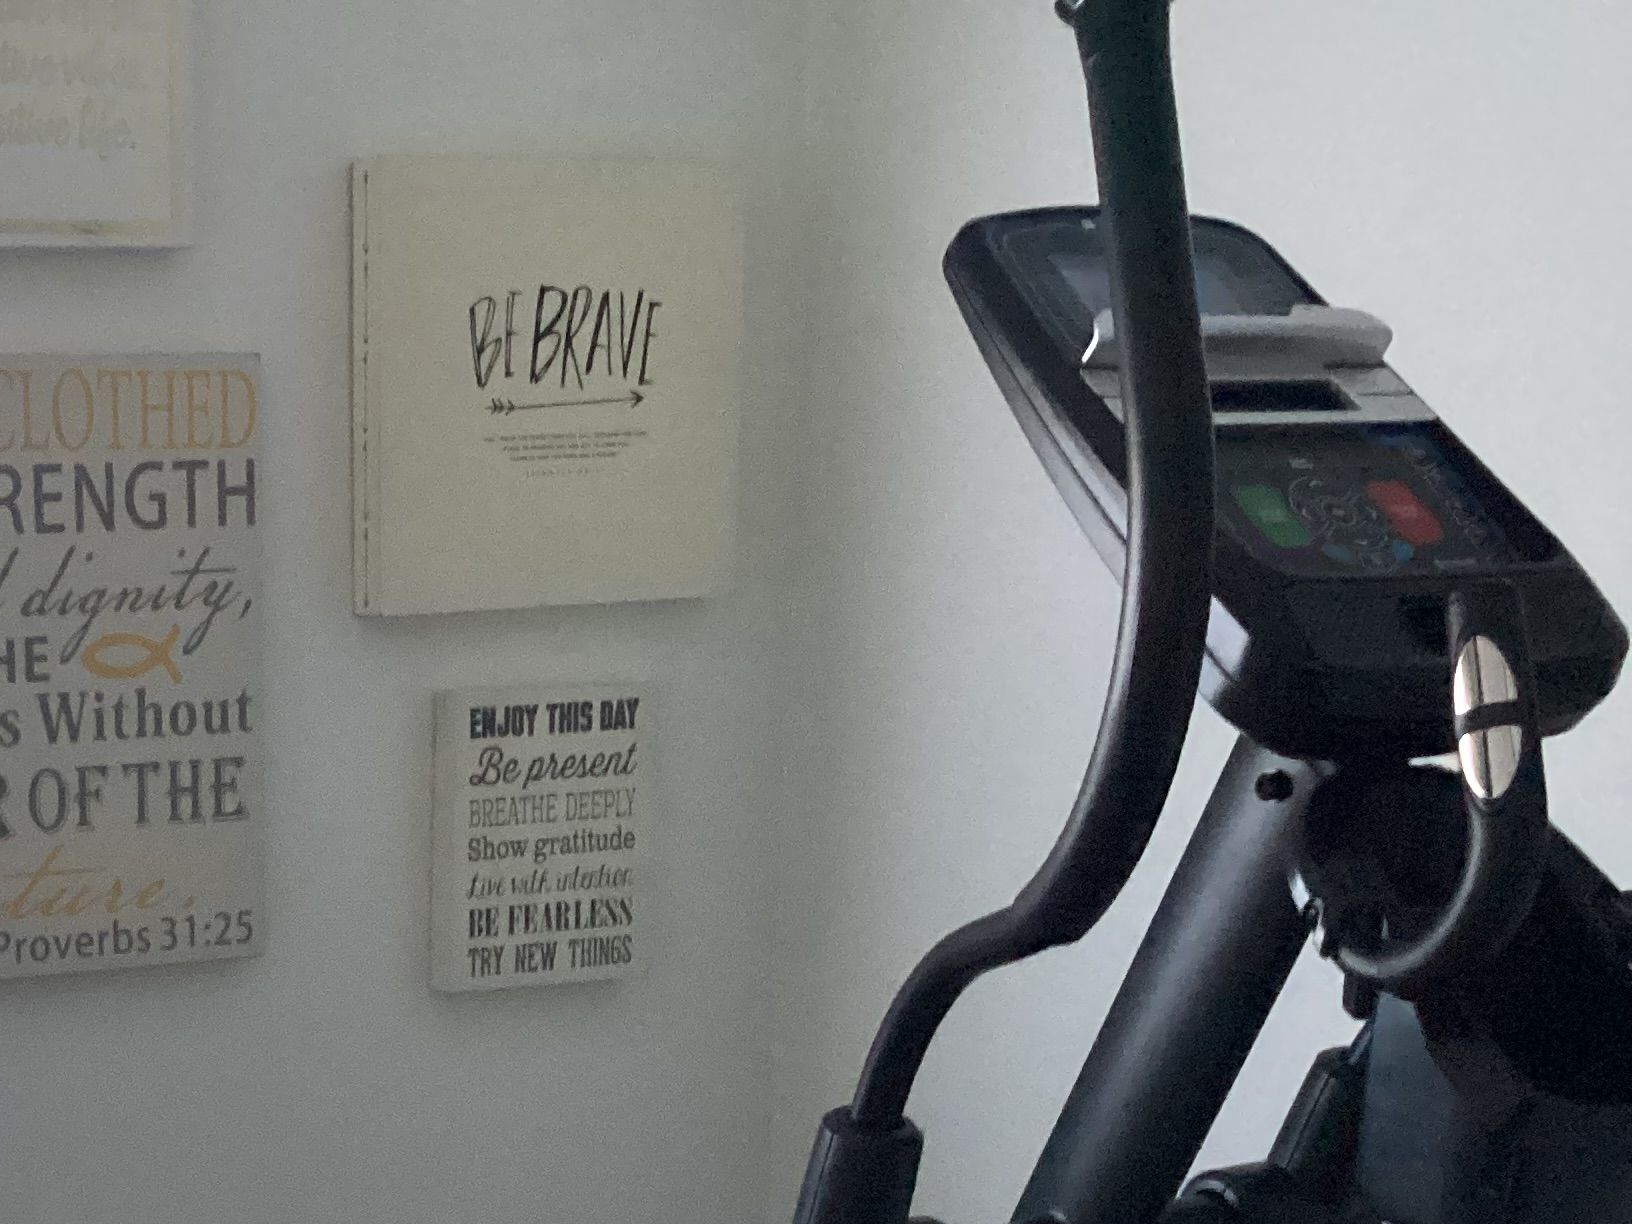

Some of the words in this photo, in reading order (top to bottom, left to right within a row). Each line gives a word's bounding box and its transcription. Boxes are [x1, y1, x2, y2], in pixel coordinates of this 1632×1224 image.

[469, 290, 522, 390] BE
[530, 283, 662, 390] BRAVE
[36, 688, 253, 747] Without
[469, 704, 539, 739] ENJOY
[546, 700, 593, 734] THIS
[599, 697, 640, 731] DAY
[469, 746, 521, 786] Be
[522, 743, 638, 789] present
[28, 765, 109, 835] OF
[121, 756, 248, 824] THE
[468, 794, 558, 828] BREATHE
[565, 787, 636, 821] DEEPLY
[468, 836, 529, 862] Show
[534, 825, 636, 864] gratitude
[160, 909, 254, 952] 31:25
[469, 907, 499, 939] BE
[508, 897, 634, 936] FEARLESS
[468, 946, 505, 978] TRY
[514, 941, 558, 973] NEW
[568, 934, 633, 968] THINGS
